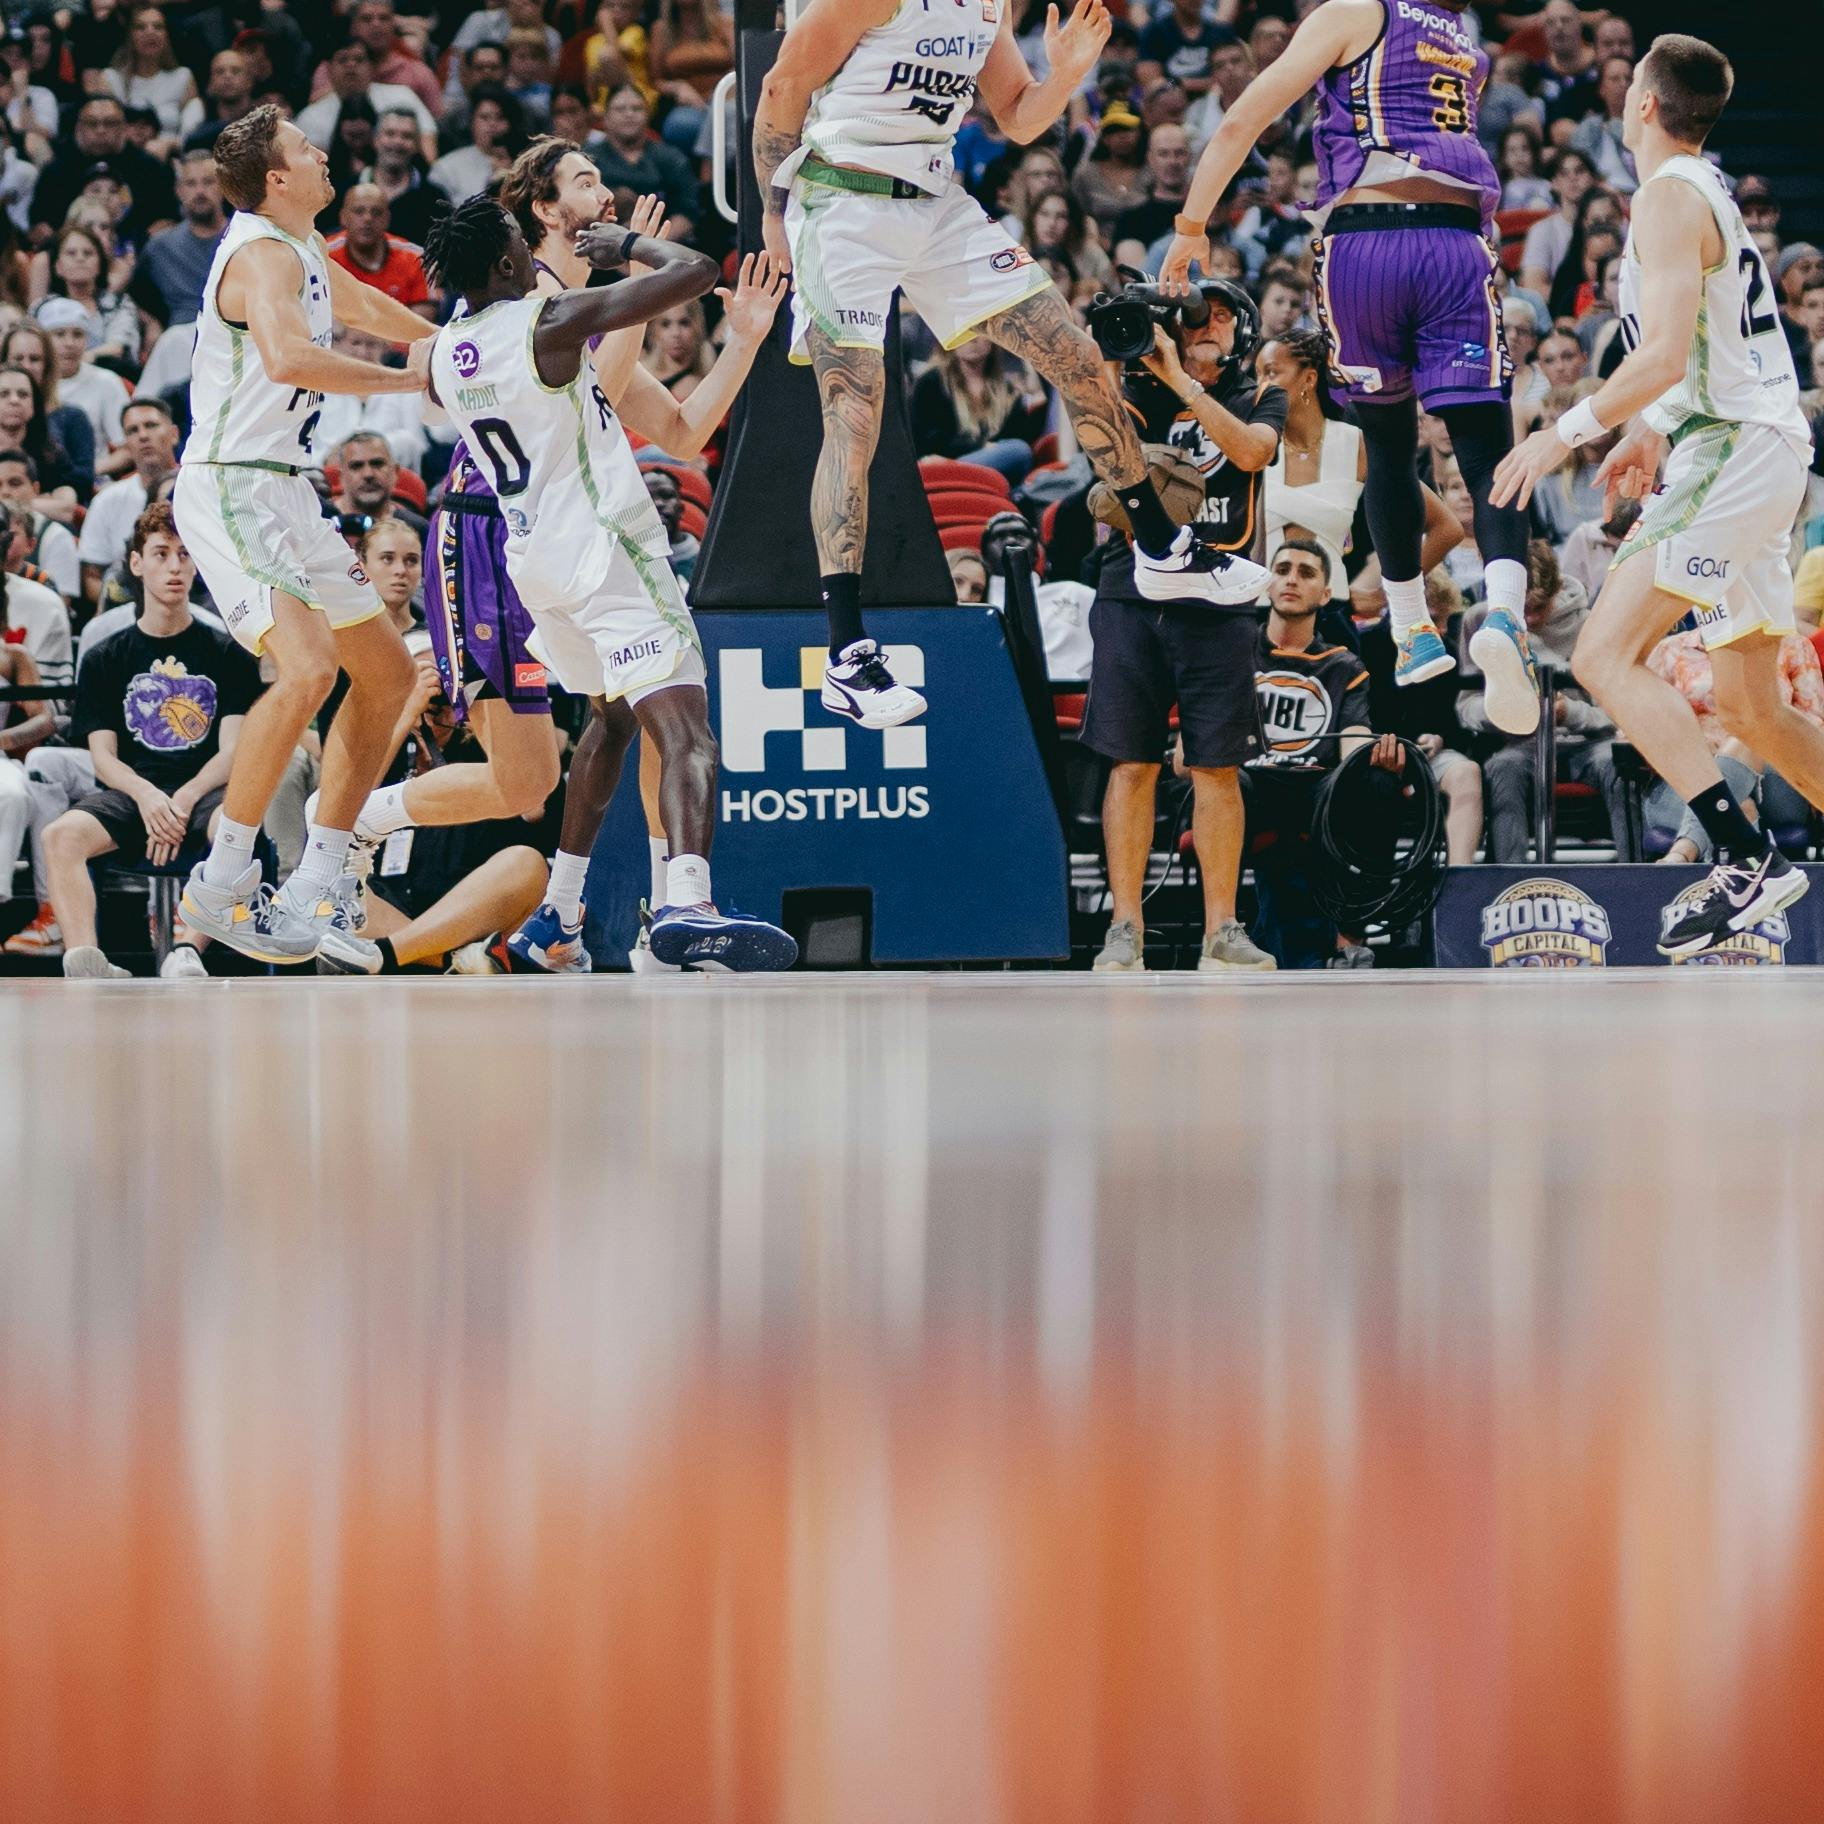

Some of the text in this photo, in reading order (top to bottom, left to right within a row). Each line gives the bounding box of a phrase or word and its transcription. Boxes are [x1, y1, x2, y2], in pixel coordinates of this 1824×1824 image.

[916, 36, 966, 57] GOAT
[1429, 72, 1470, 134] 3
[455, 383, 502, 413] MADUT
[469, 416, 531, 498] 0
[1686, 556, 1732, 579] GOAT
[608, 639, 663, 671] TRADIE
[721, 786, 930, 823] HOSTPLUS
[1481, 897, 1612, 944] HOOPS
[1513, 931, 1583, 954] CAPITAL
